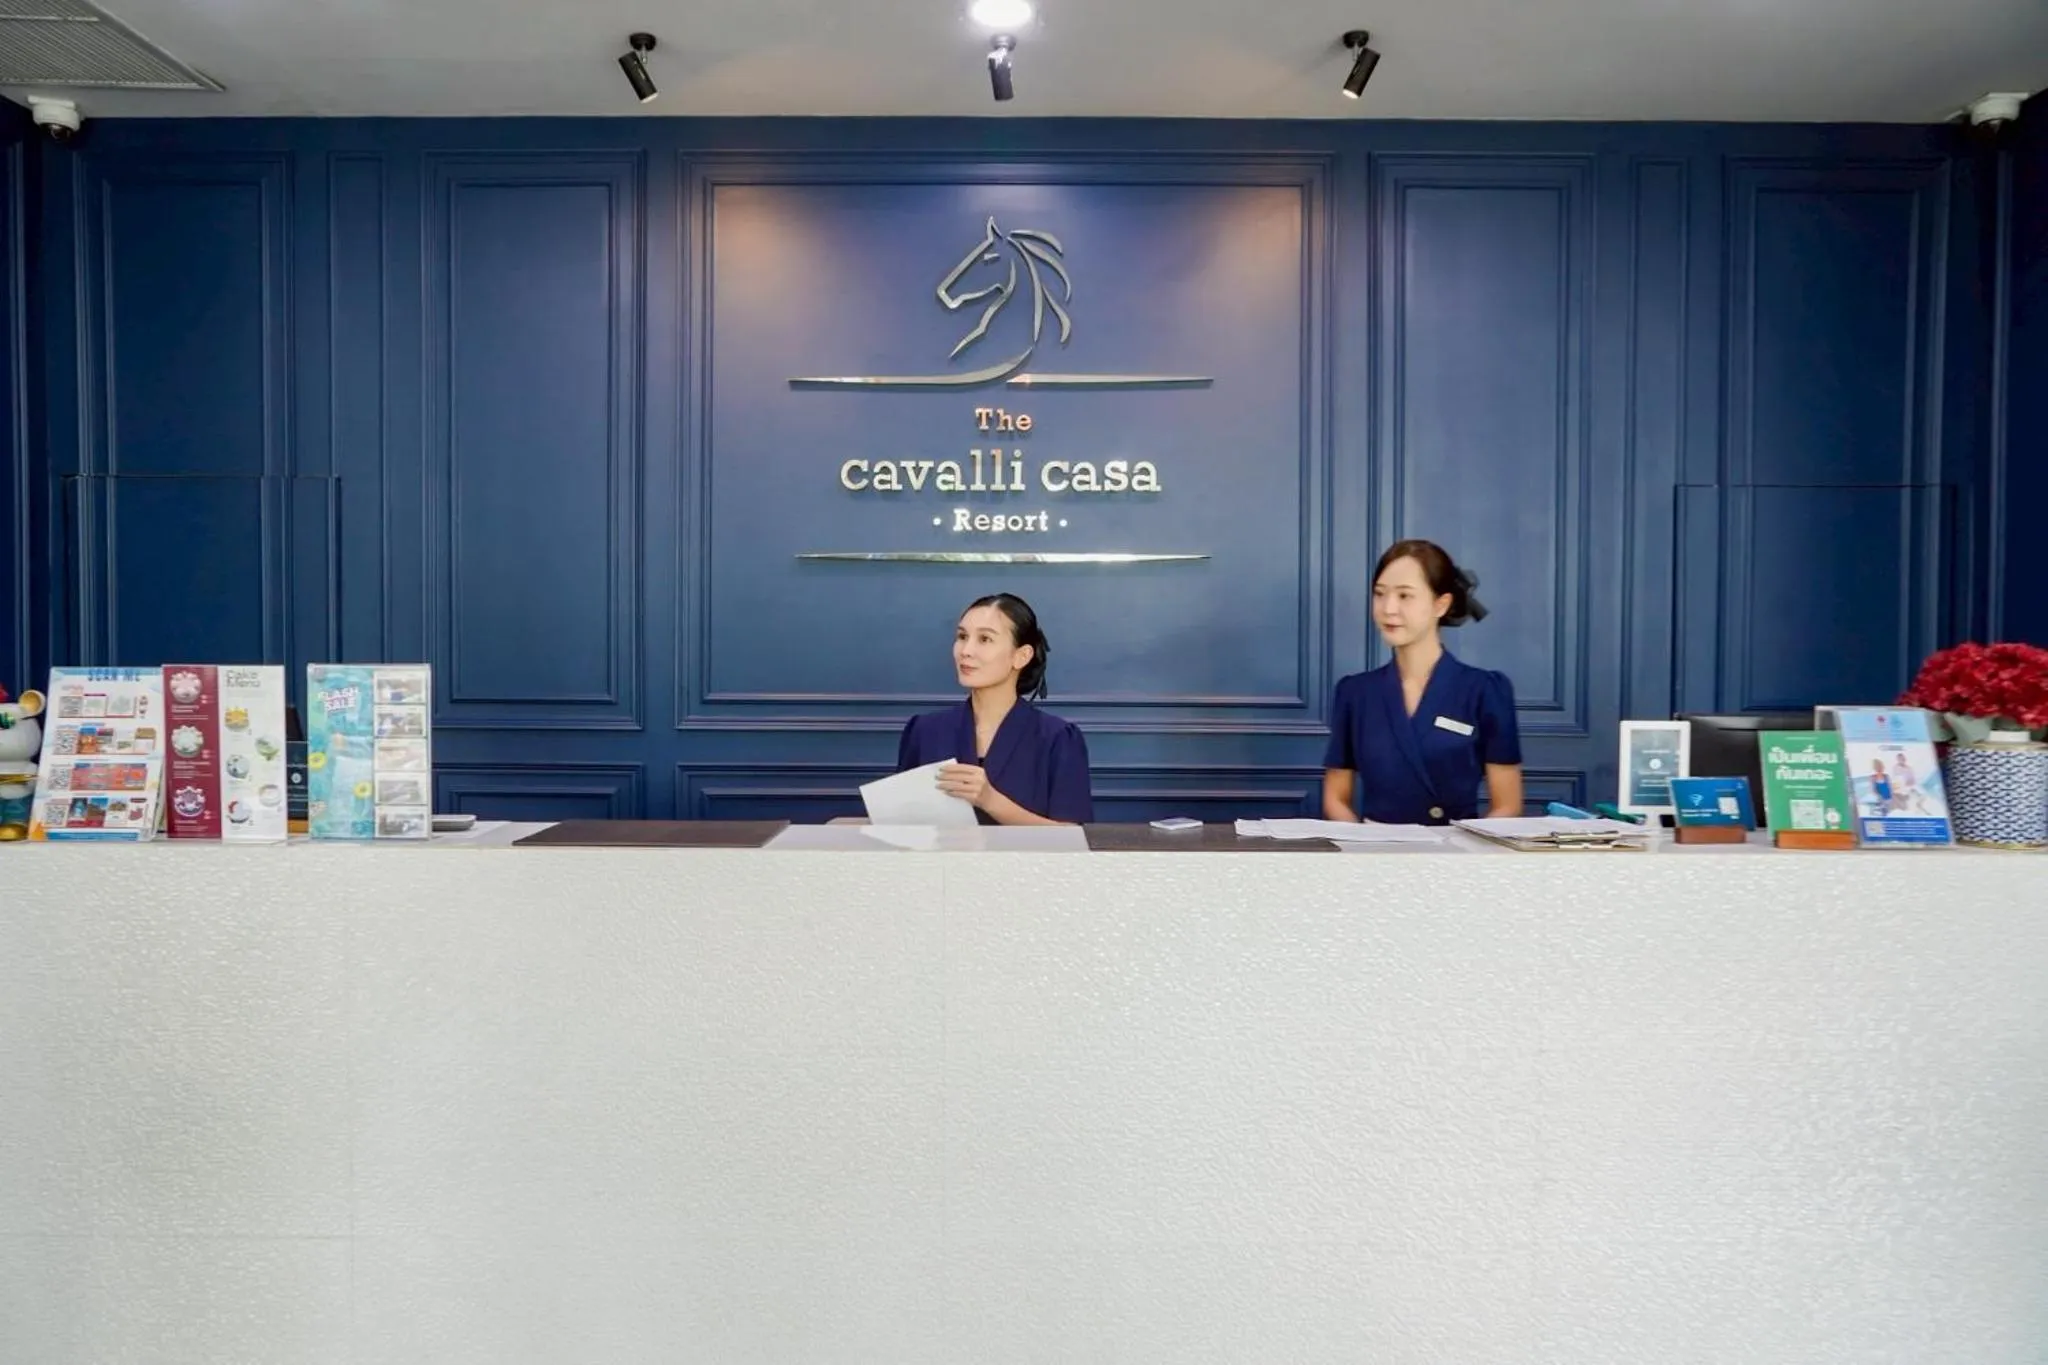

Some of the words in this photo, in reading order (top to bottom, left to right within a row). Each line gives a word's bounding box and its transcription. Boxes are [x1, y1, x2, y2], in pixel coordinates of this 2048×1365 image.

[975, 408, 1033, 432] The
[840, 449, 1027, 492] cavalli
[1041, 459, 1162, 493] casa
[953, 508, 1049, 532] Resort
[226, 669, 259, 681] Cake
[226, 679, 261, 688] Menu
[324, 697, 357, 711] SALE
[1768, 744, 1839, 764] เป็นเพื่อน
